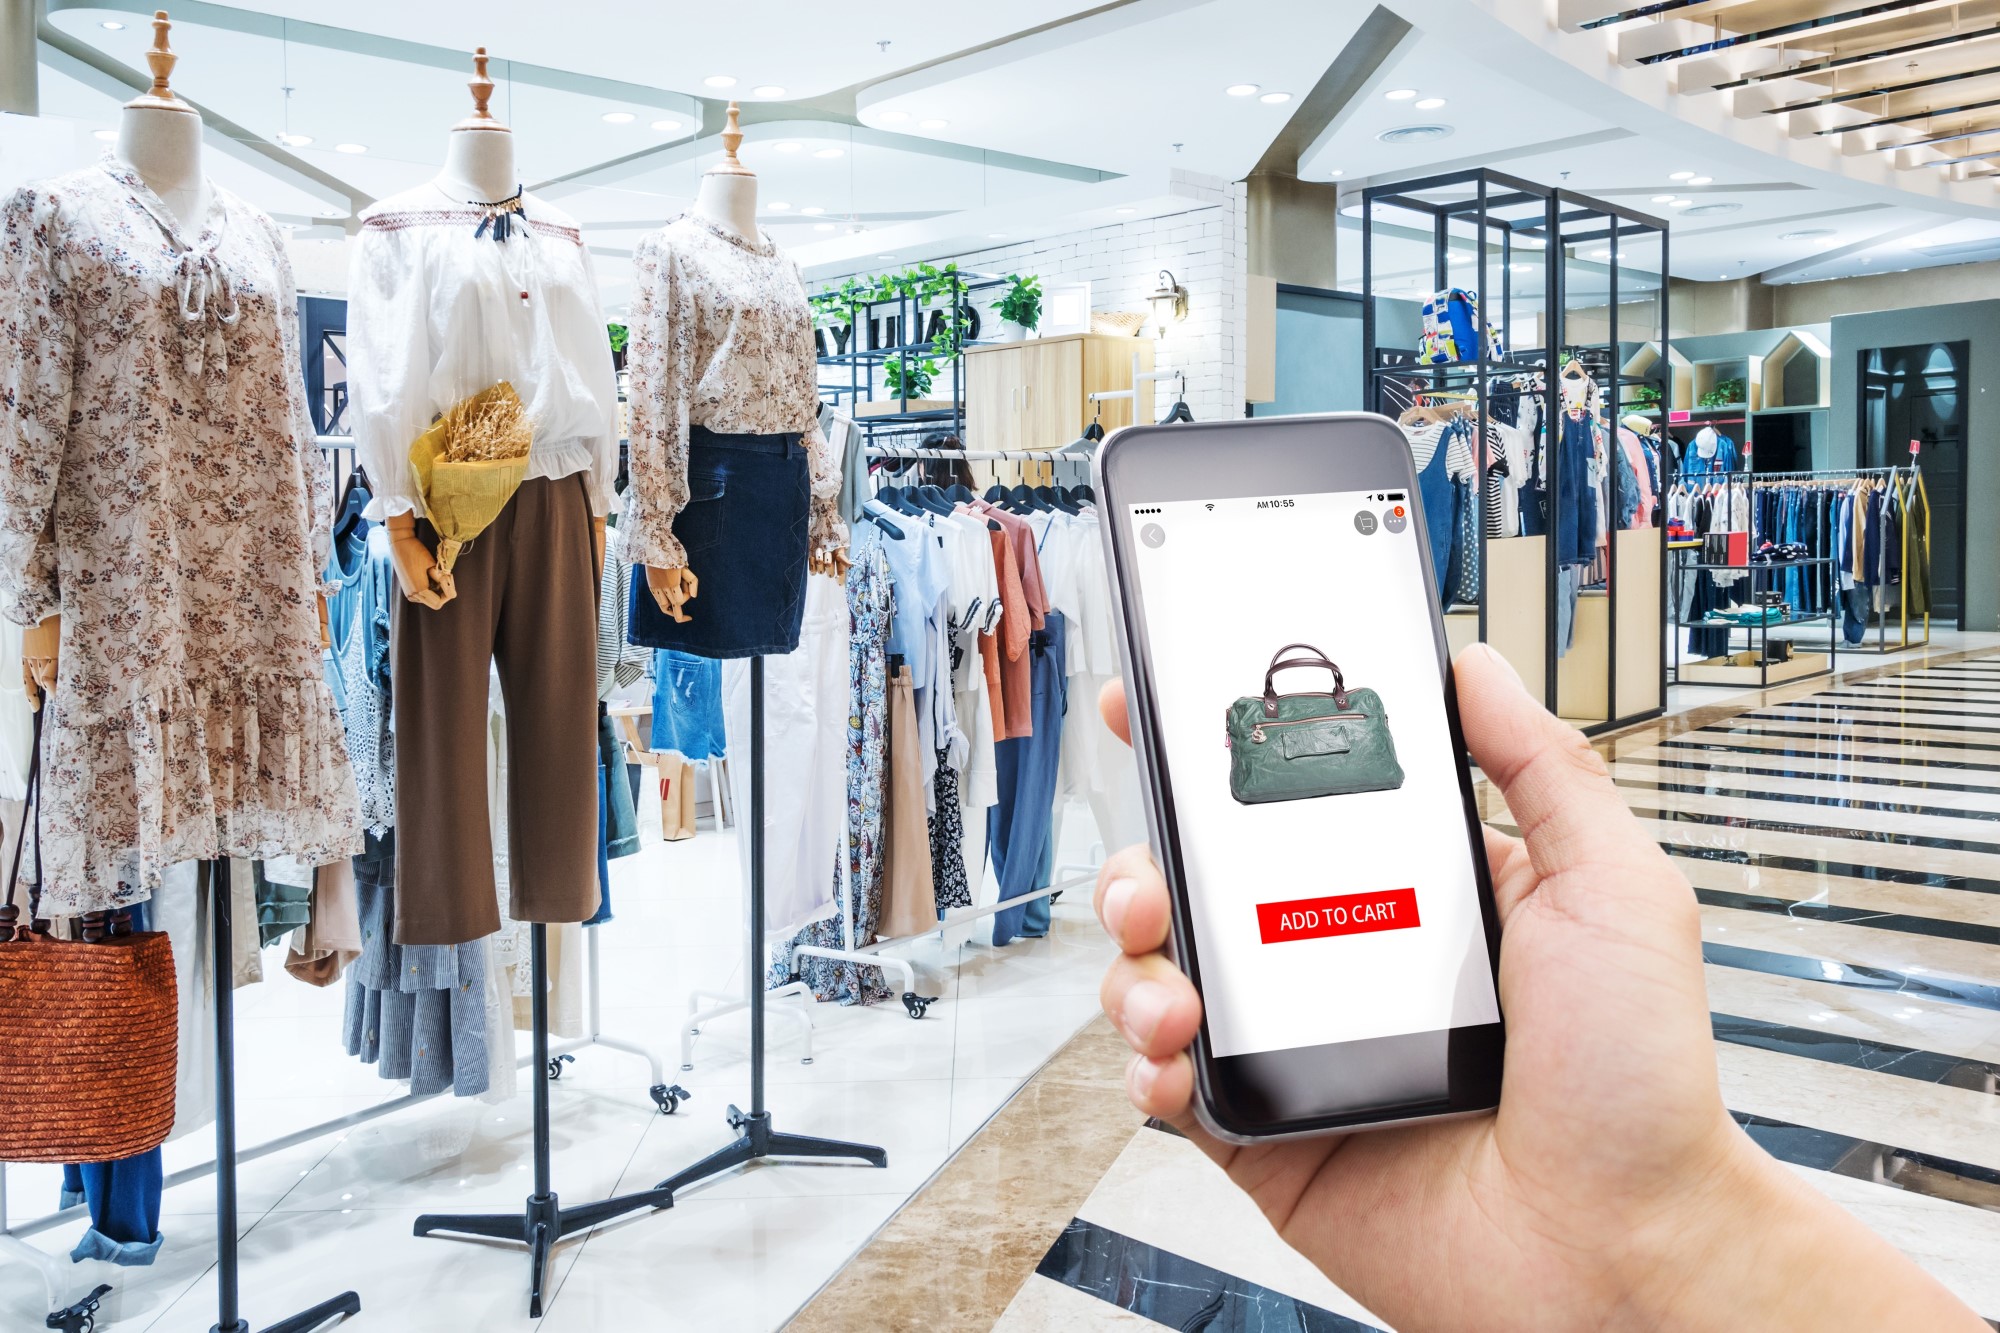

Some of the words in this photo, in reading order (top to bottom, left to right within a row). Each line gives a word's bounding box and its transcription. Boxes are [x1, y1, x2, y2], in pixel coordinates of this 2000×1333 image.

[1257, 499, 1295, 509] AM10:55
[1280, 910, 1319, 931] ADD
[1321, 907, 1348, 926] TO
[1352, 901, 1397, 923] CART
